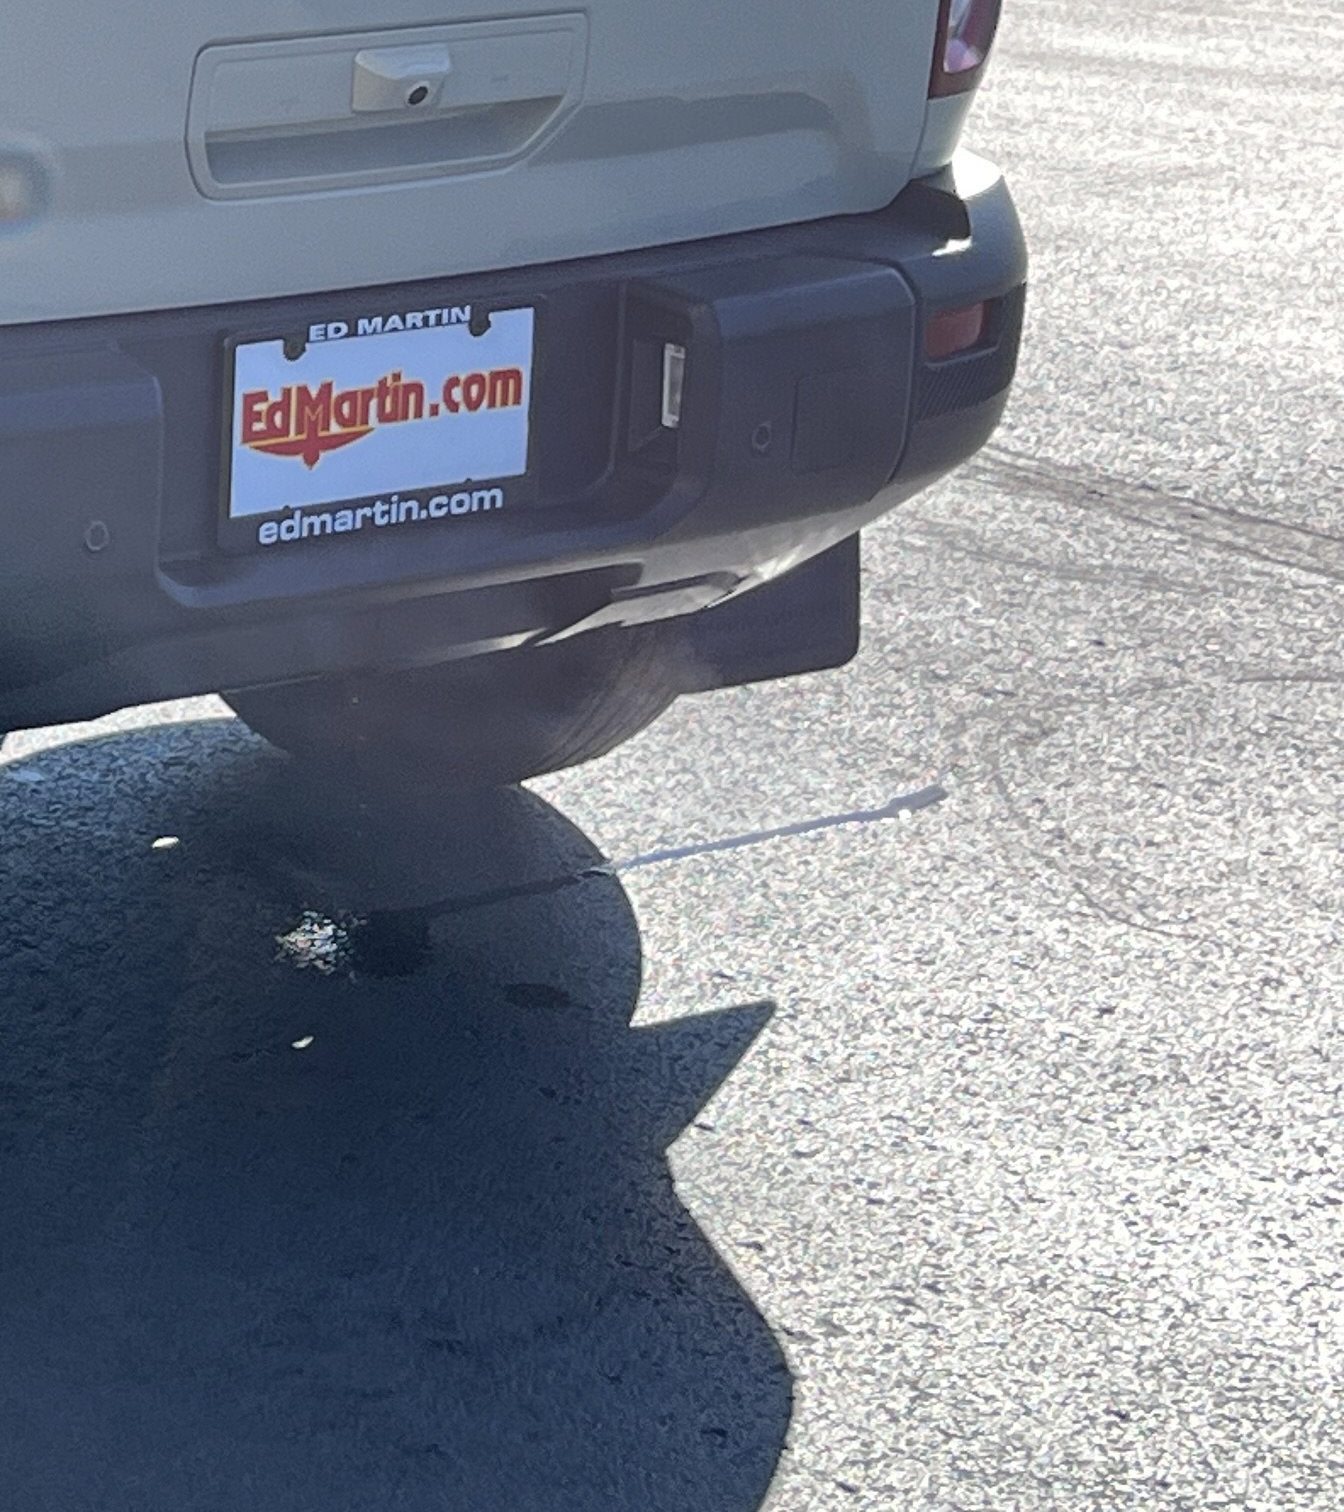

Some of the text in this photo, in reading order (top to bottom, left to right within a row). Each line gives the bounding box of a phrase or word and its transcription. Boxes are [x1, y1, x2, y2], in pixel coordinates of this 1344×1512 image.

[309, 304, 471, 342] ED MARTIN
[240, 367, 523, 445] EdMartin.com
[258, 486, 504, 546] edmartin.com
